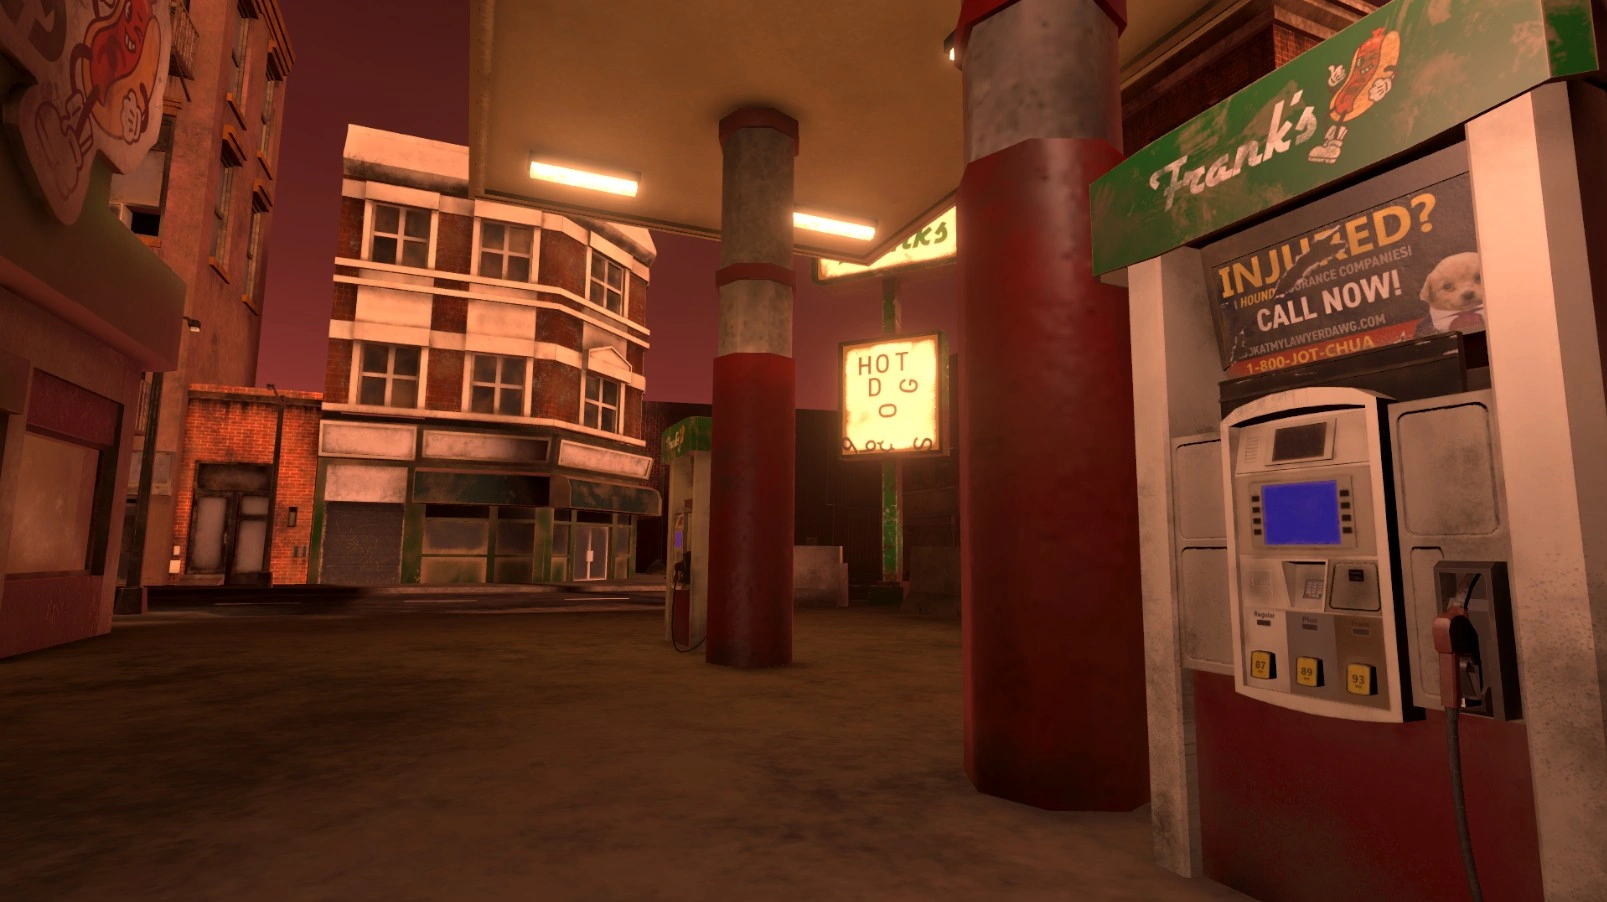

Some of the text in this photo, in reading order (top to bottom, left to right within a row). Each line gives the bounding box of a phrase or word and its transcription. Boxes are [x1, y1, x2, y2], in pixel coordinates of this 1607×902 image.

[1150, 90, 1317, 212] Frank's
[1240, 287, 1275, 308] HOUND
[1339, 245, 1412, 277] COMPANIES!
[1257, 269, 1402, 332] CALL NOW!
[858, 352, 909, 376] HOT
[1246, 335, 1374, 375] 1-800-JOT-CHUA
[1256, 660, 1266, 670] 87
[1301, 667, 1313, 676] 89
[1352, 674, 1366, 685] 93
